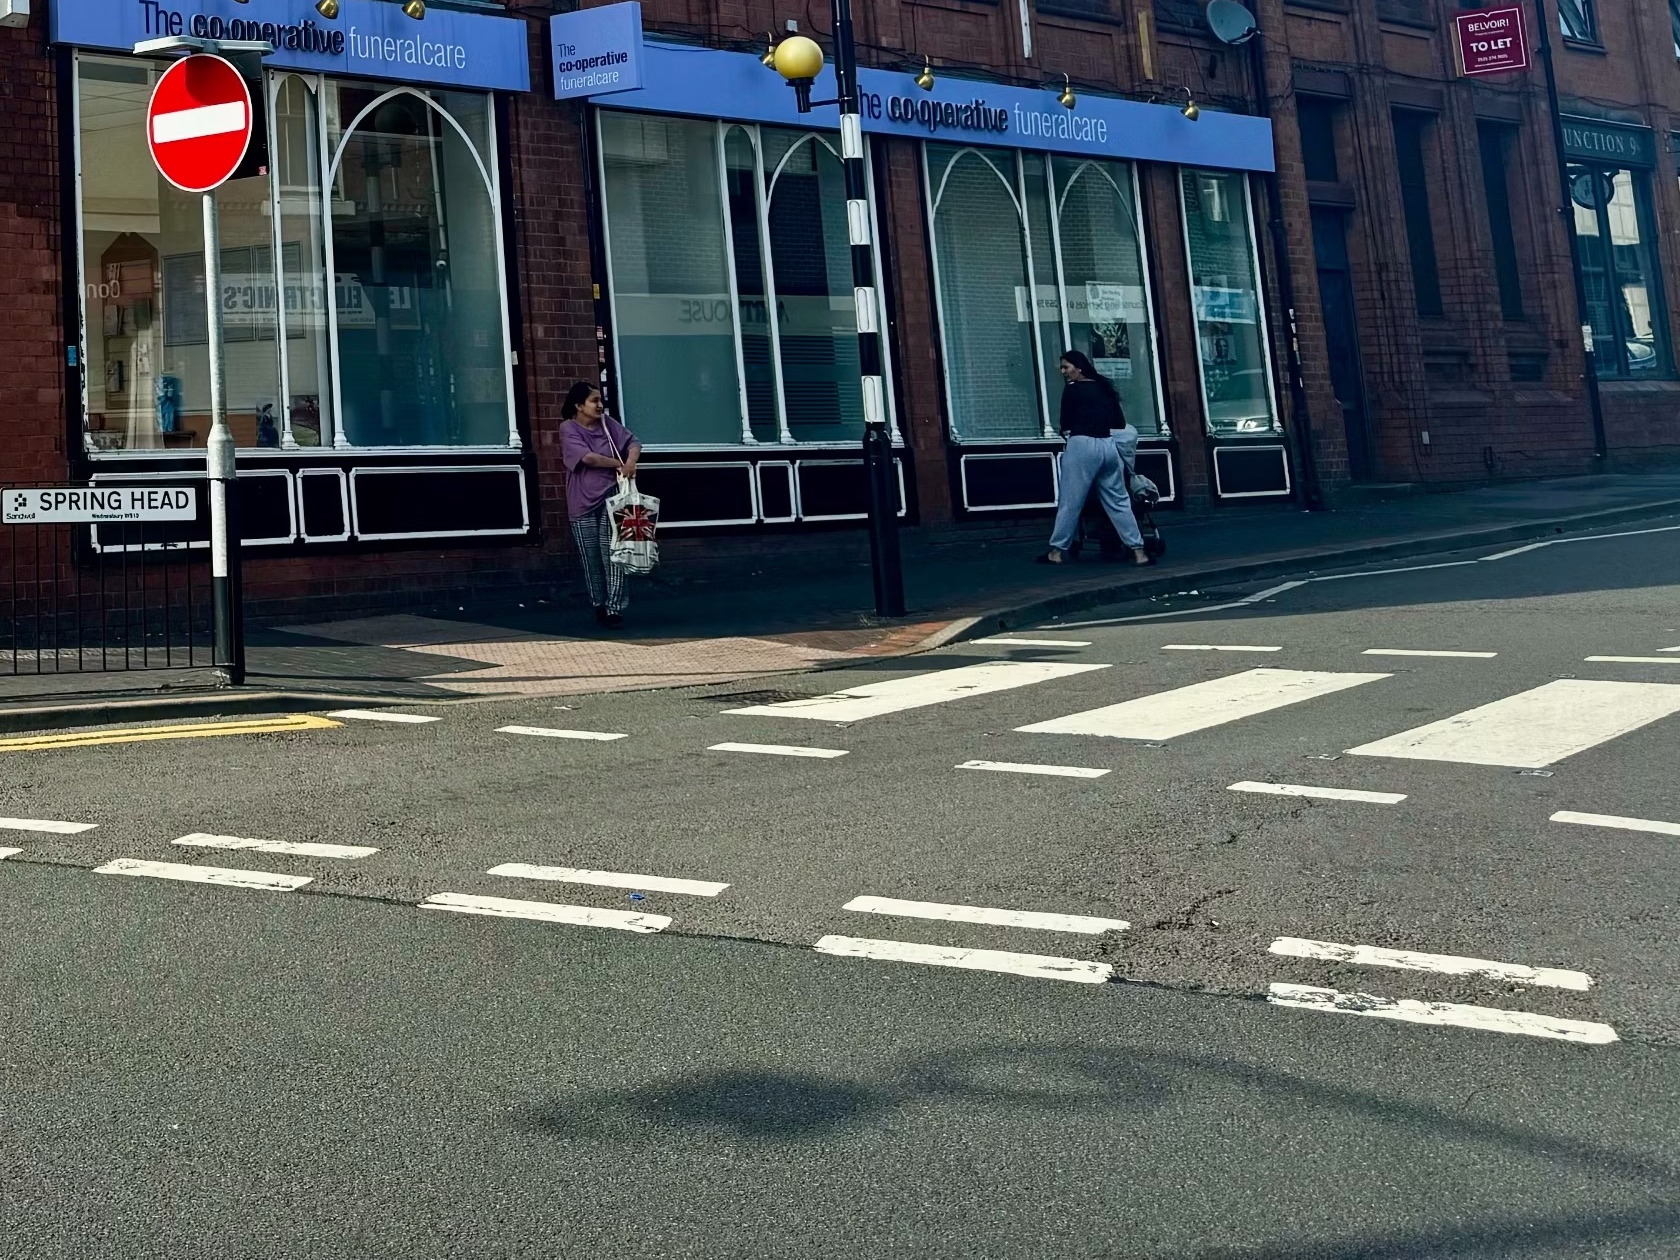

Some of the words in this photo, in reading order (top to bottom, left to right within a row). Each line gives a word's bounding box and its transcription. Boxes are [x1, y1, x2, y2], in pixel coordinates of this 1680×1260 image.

[347, 24, 467, 70] funeralcare
[557, 43, 576, 58] The
[1469, 41, 1489, 53] TO
[1490, 37, 1513, 50] LET
[560, 71, 620, 91] funeralcare
[857, 84, 882, 120] he
[1013, 101, 1108, 143] funeralcare
[1563, 127, 1625, 154] UNCTION
[39, 491, 122, 511] SPRING
[131, 490, 190, 510] HEAD
